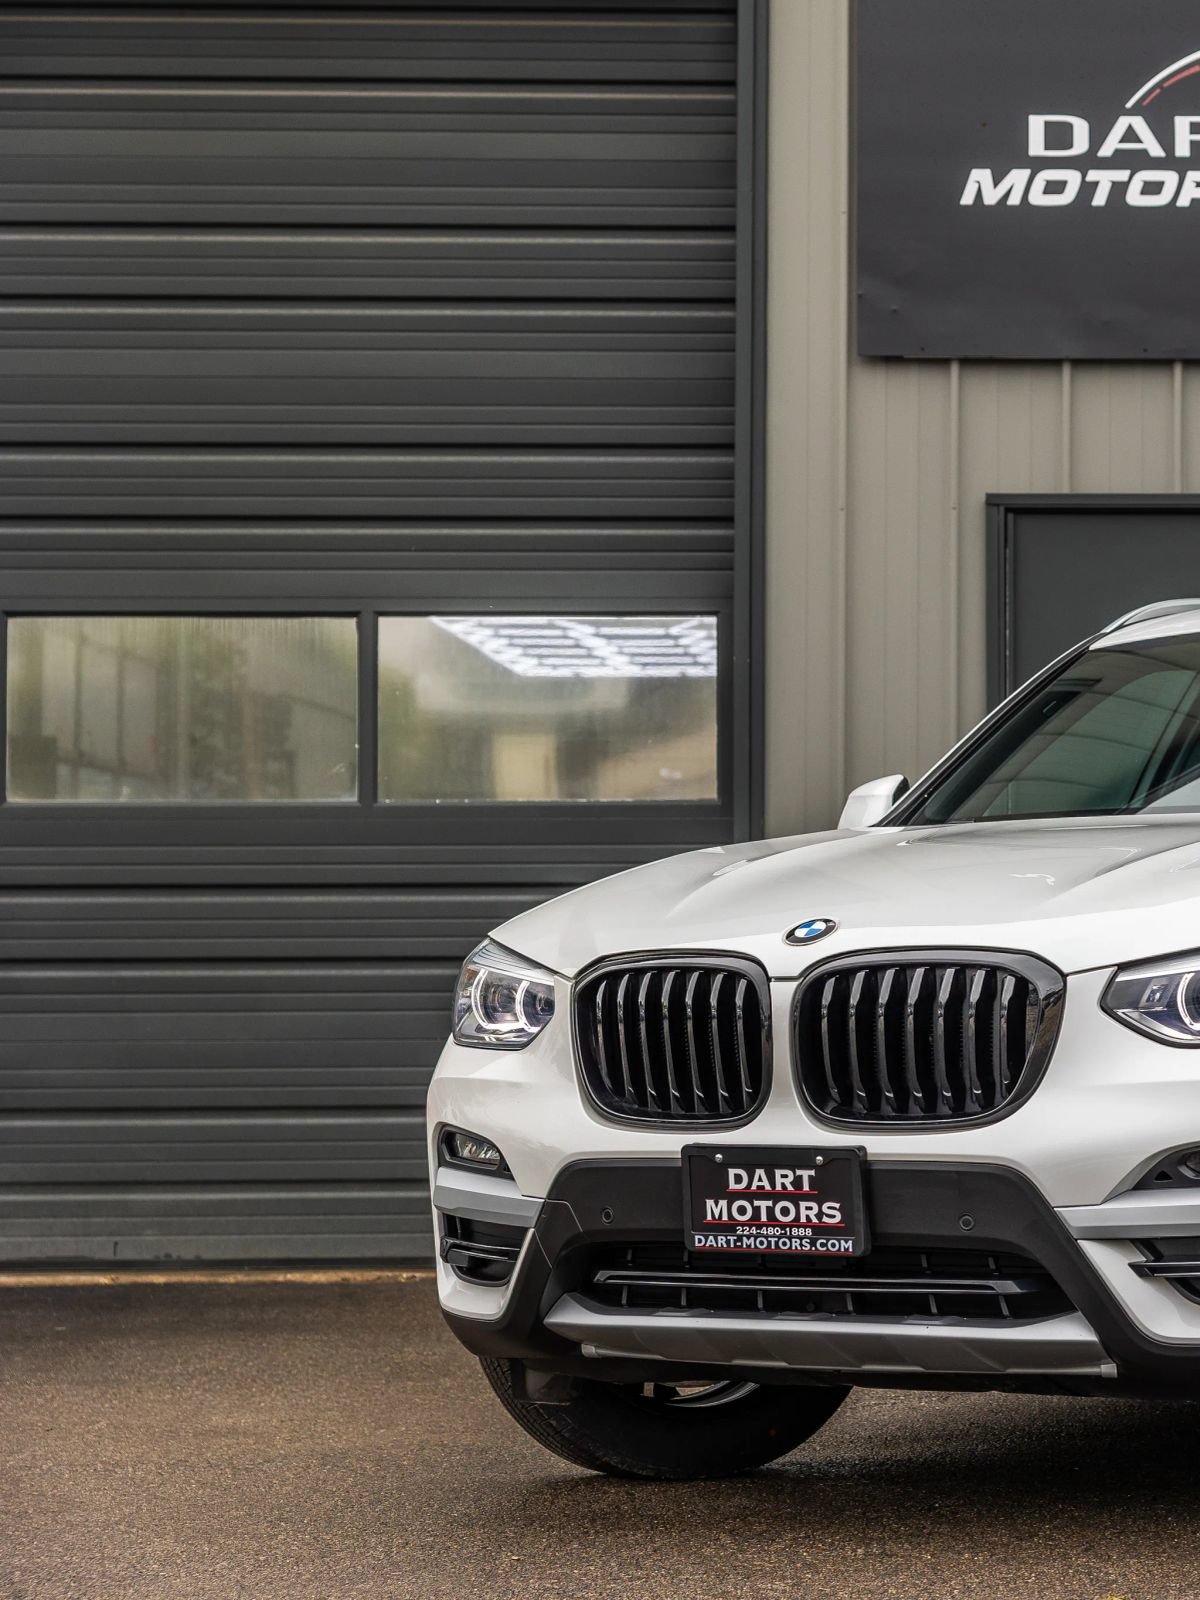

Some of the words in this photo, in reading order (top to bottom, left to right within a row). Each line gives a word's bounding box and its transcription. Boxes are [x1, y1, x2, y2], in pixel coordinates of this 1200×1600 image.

[727, 1168, 816, 1191] DART
[705, 1199, 842, 1223] MOTORS
[736, 1227, 812, 1236] 224-480-1888
[694, 1235, 853, 1252] DART-MOTORS.COM
